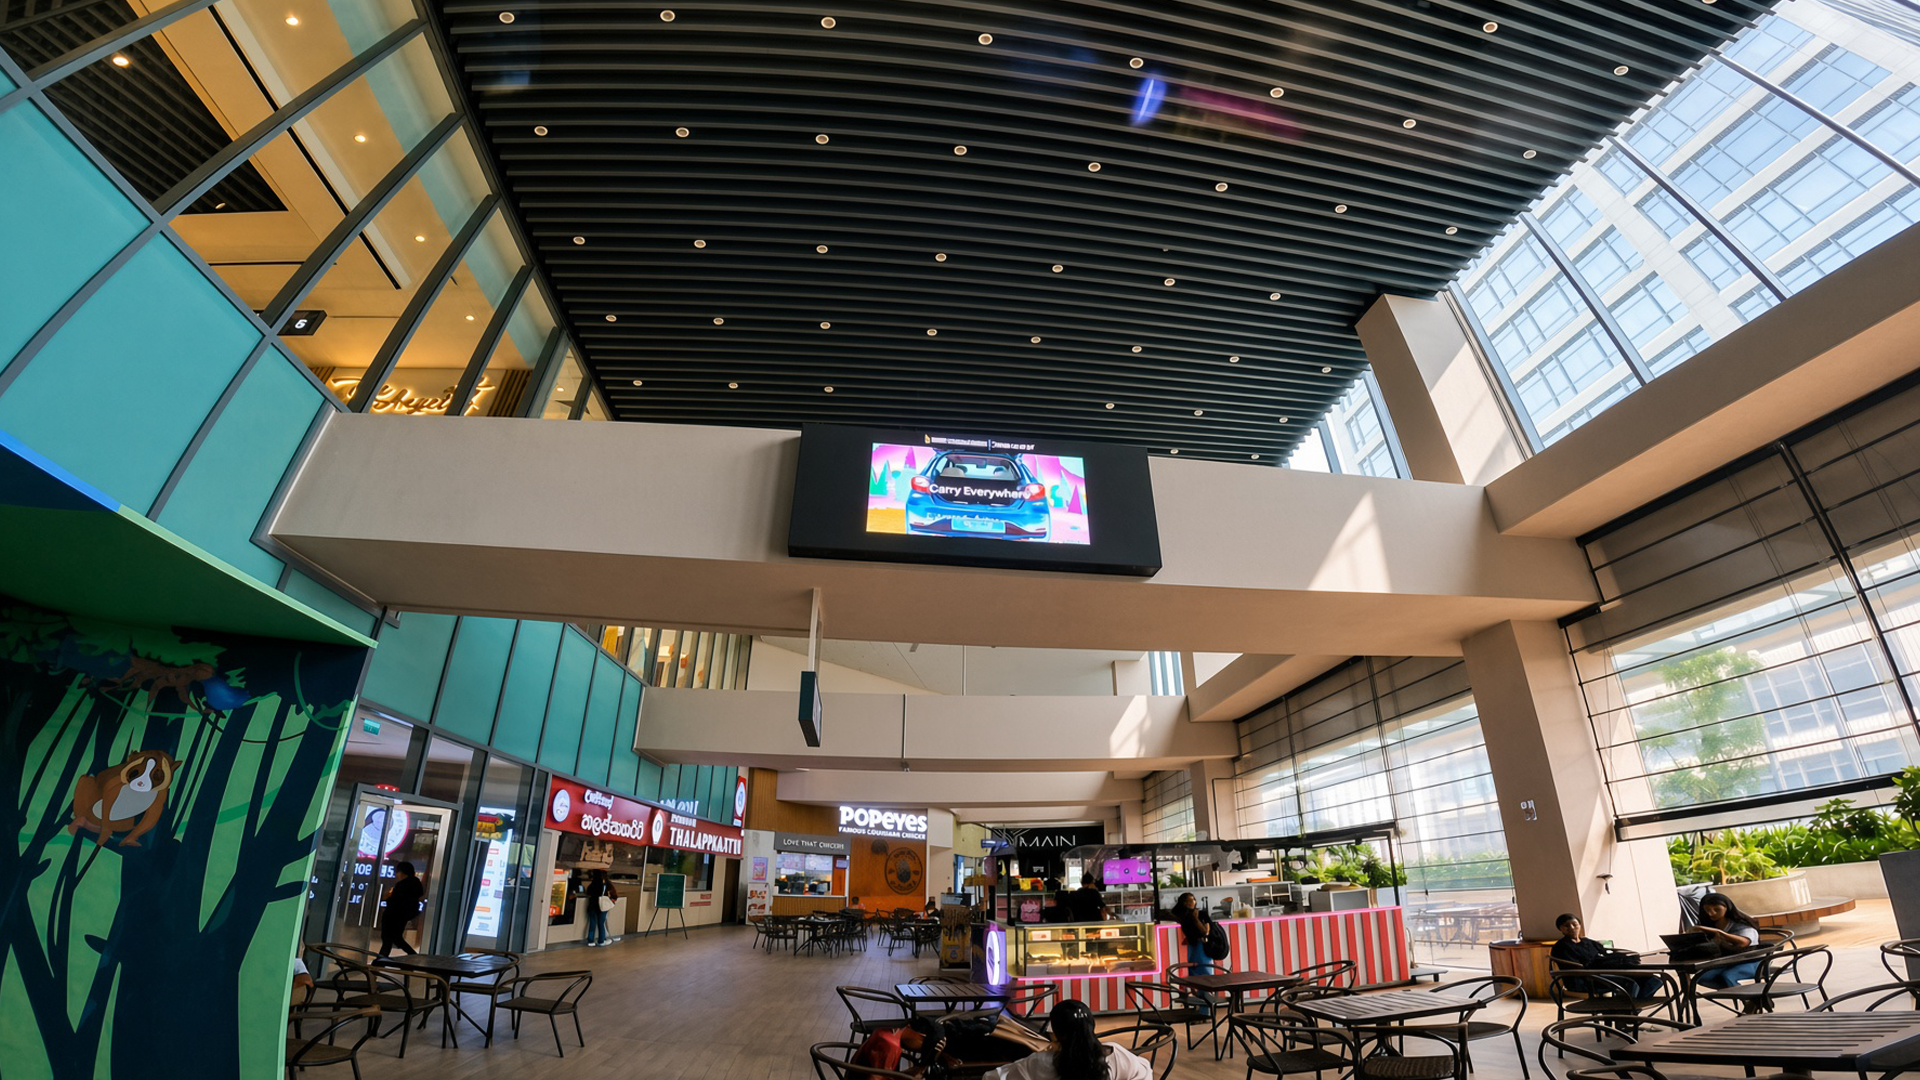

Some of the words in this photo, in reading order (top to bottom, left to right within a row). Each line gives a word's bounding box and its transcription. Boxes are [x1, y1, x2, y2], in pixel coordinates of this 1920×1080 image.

[294, 318, 308, 329] 6
[929, 483, 962, 497] Carry
[839, 805, 928, 832] POPEYES
[783, 838, 799, 846] LOVE
[801, 840, 818, 848] THAT
[1019, 834, 1076, 847] MAIN
